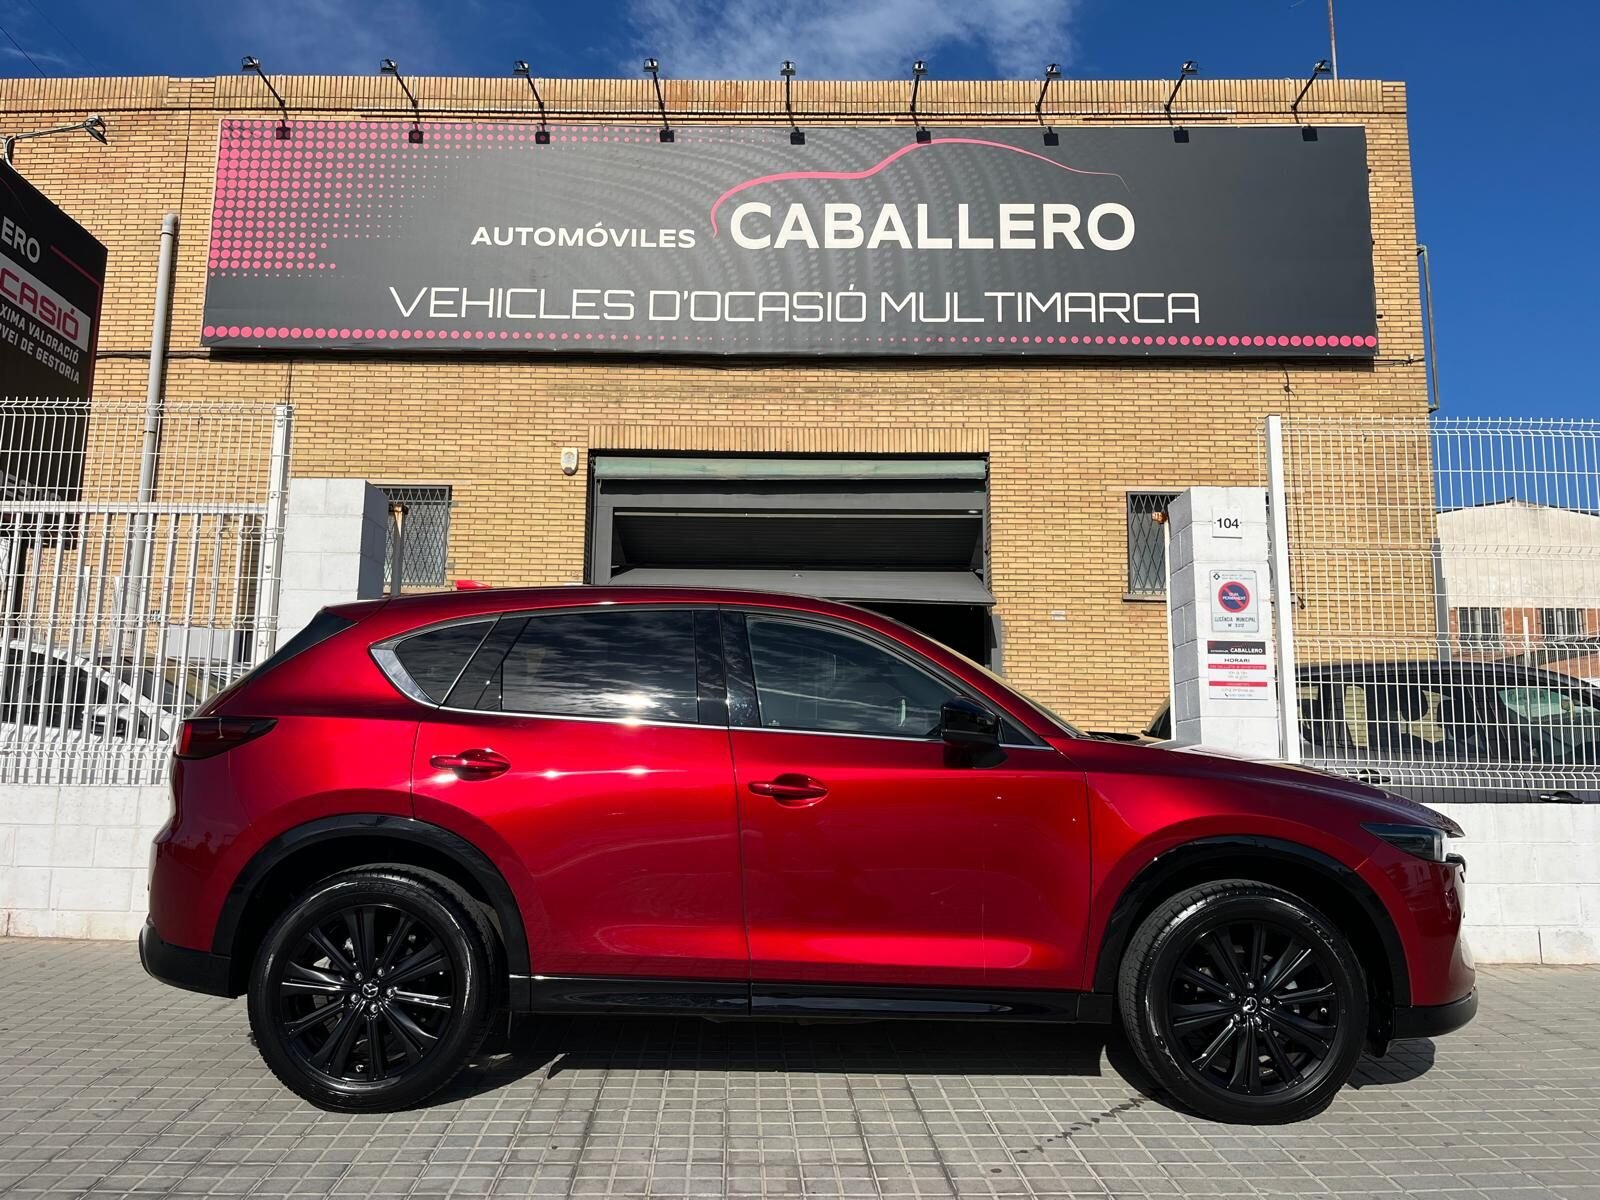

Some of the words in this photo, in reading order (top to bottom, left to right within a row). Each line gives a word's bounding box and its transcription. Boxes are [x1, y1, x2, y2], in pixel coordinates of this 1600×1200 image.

[471, 221, 696, 249] AUTOMÓVILES
[730, 202, 1136, 251] CABALLERO
[389, 286, 635, 320] VEHICLES
[649, 284, 867, 323] D'OCASIÓ
[881, 291, 1201, 324] MULTIMARCA
[20, 336, 34, 356] DE
[36, 347, 80, 385] GESTORIA
[29, 321, 79, 364] VALORACIÓ
[1216, 517, 1240, 529] 104
